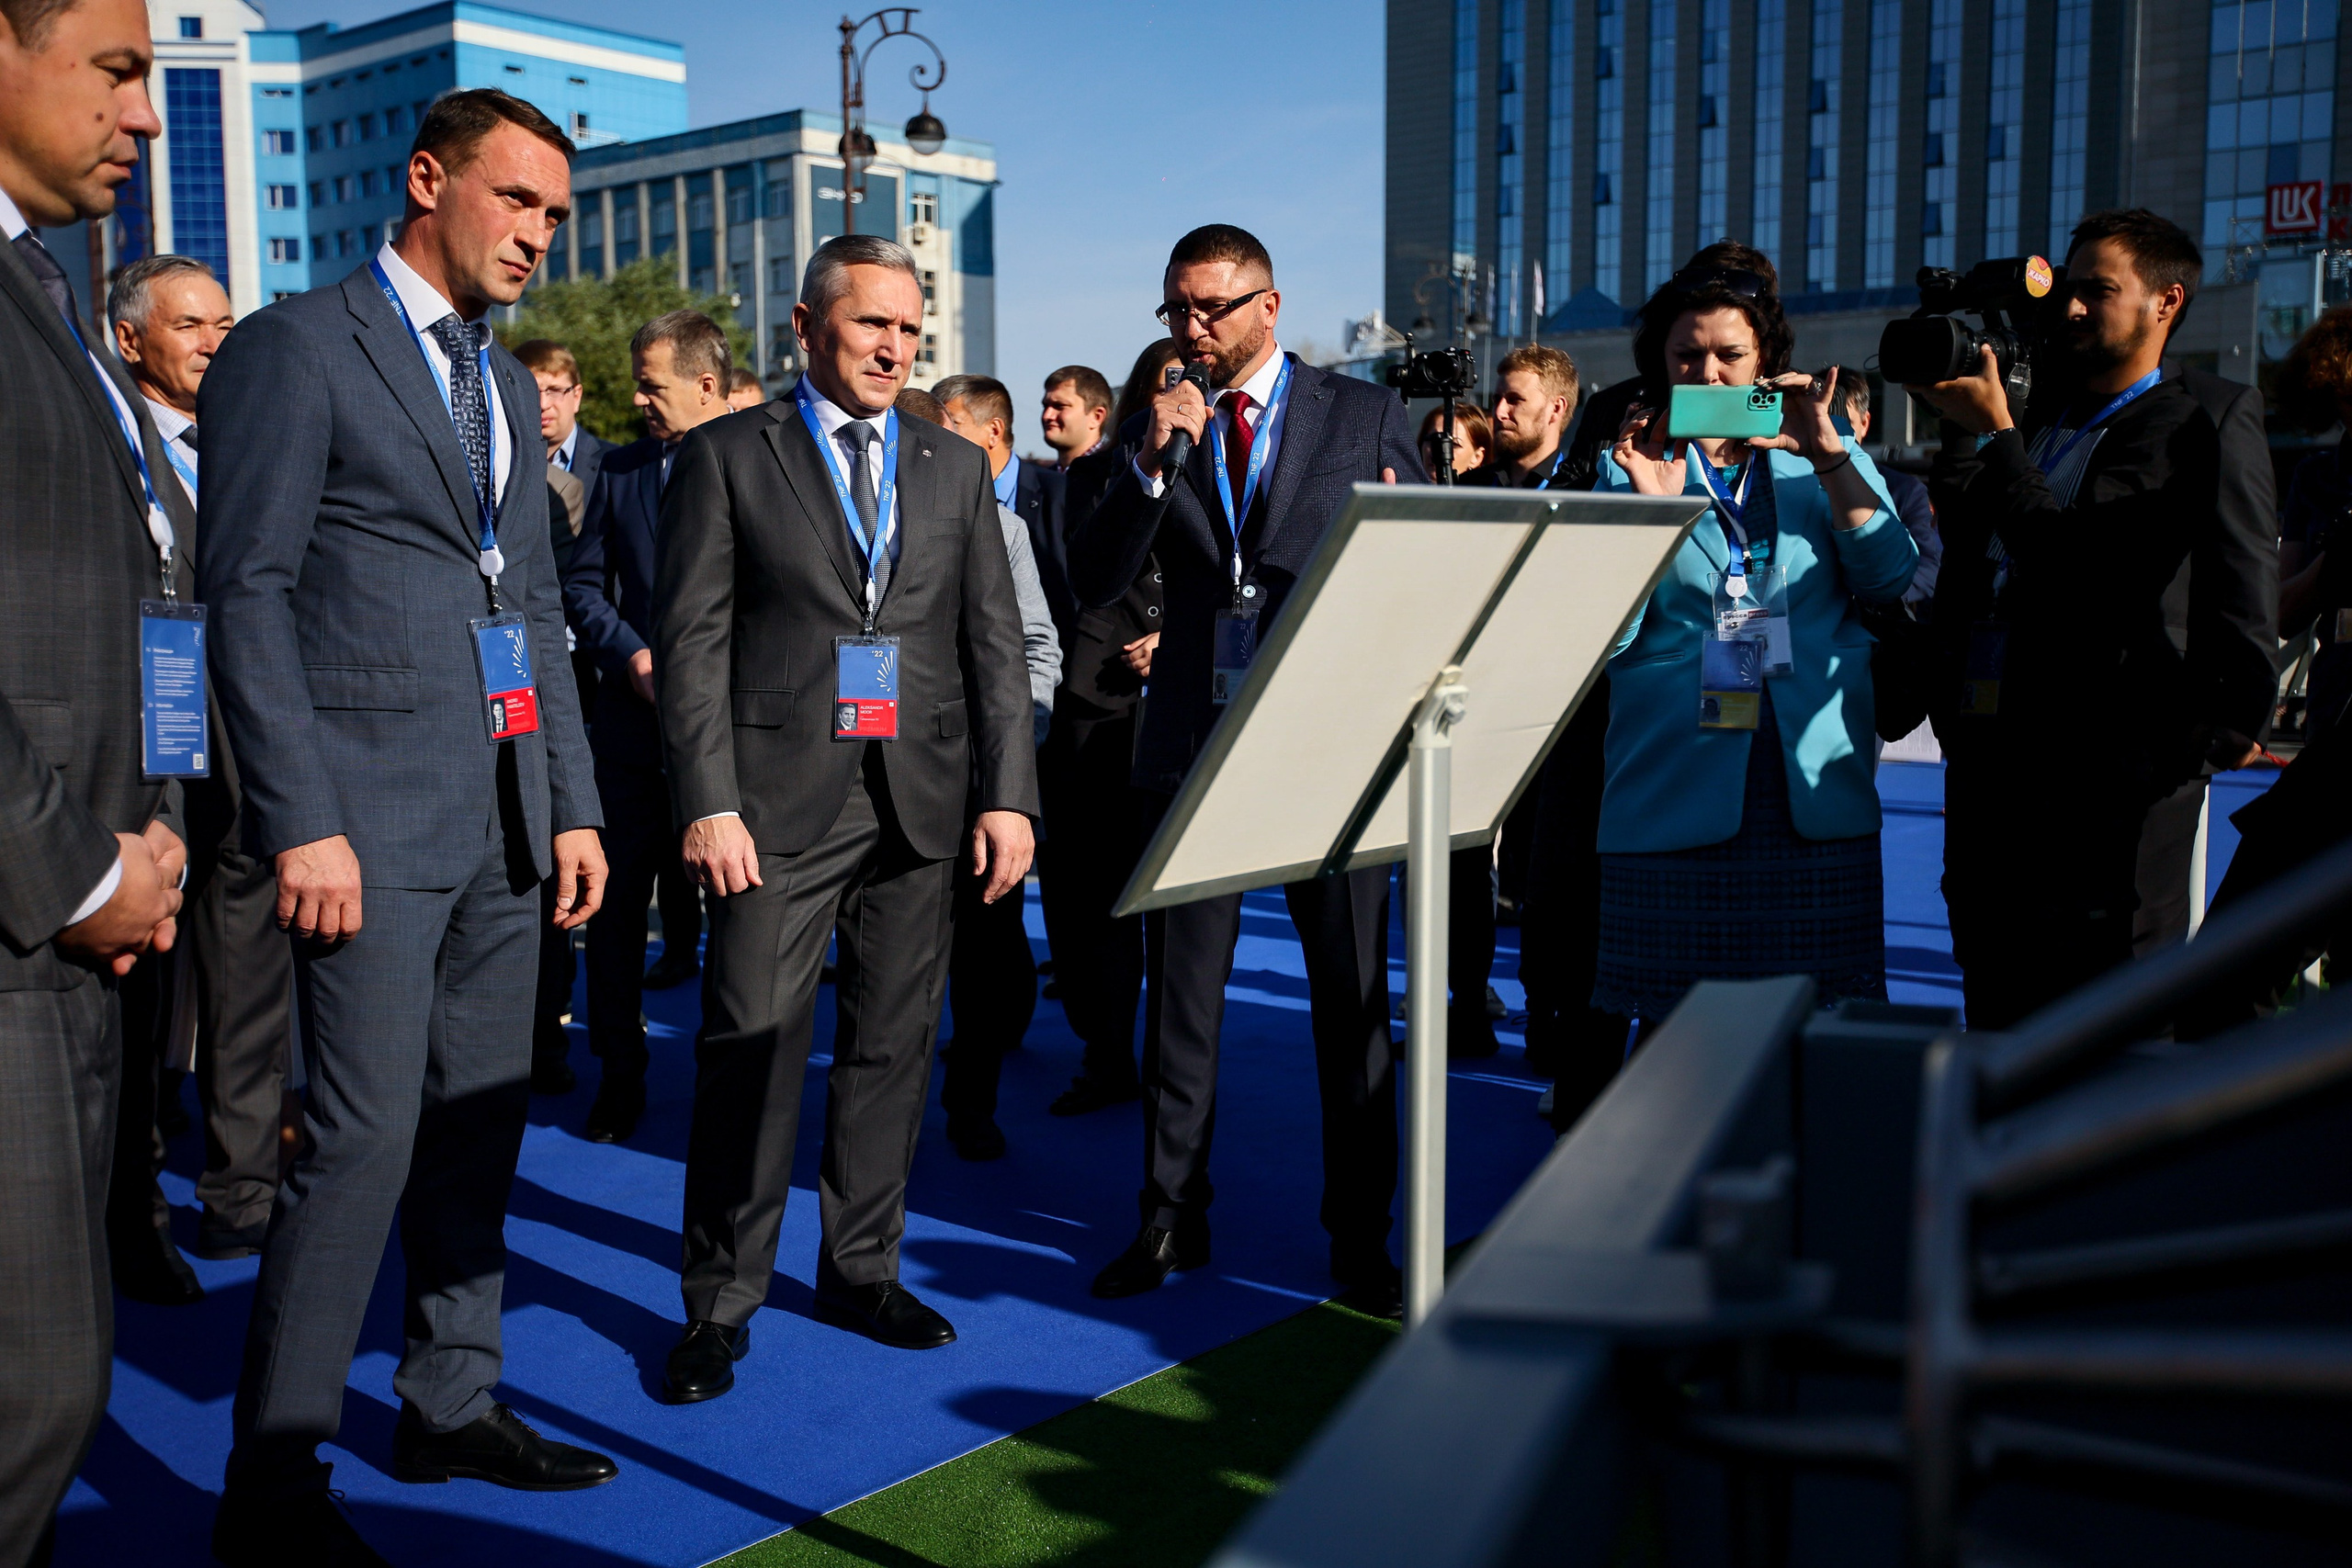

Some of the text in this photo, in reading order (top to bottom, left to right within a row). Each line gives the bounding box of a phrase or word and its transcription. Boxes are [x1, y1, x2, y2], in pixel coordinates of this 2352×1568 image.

[2028, 268, 2050, 288] ЖАРКО
[390, 299, 404, 317] TNF
[1276, 378, 1284, 389] TNF
[2110, 398, 2123, 409] TNF
[1216, 467, 1225, 479] TNF
[1250, 463, 1259, 476] TNF
[838, 485, 847, 498] TNF
